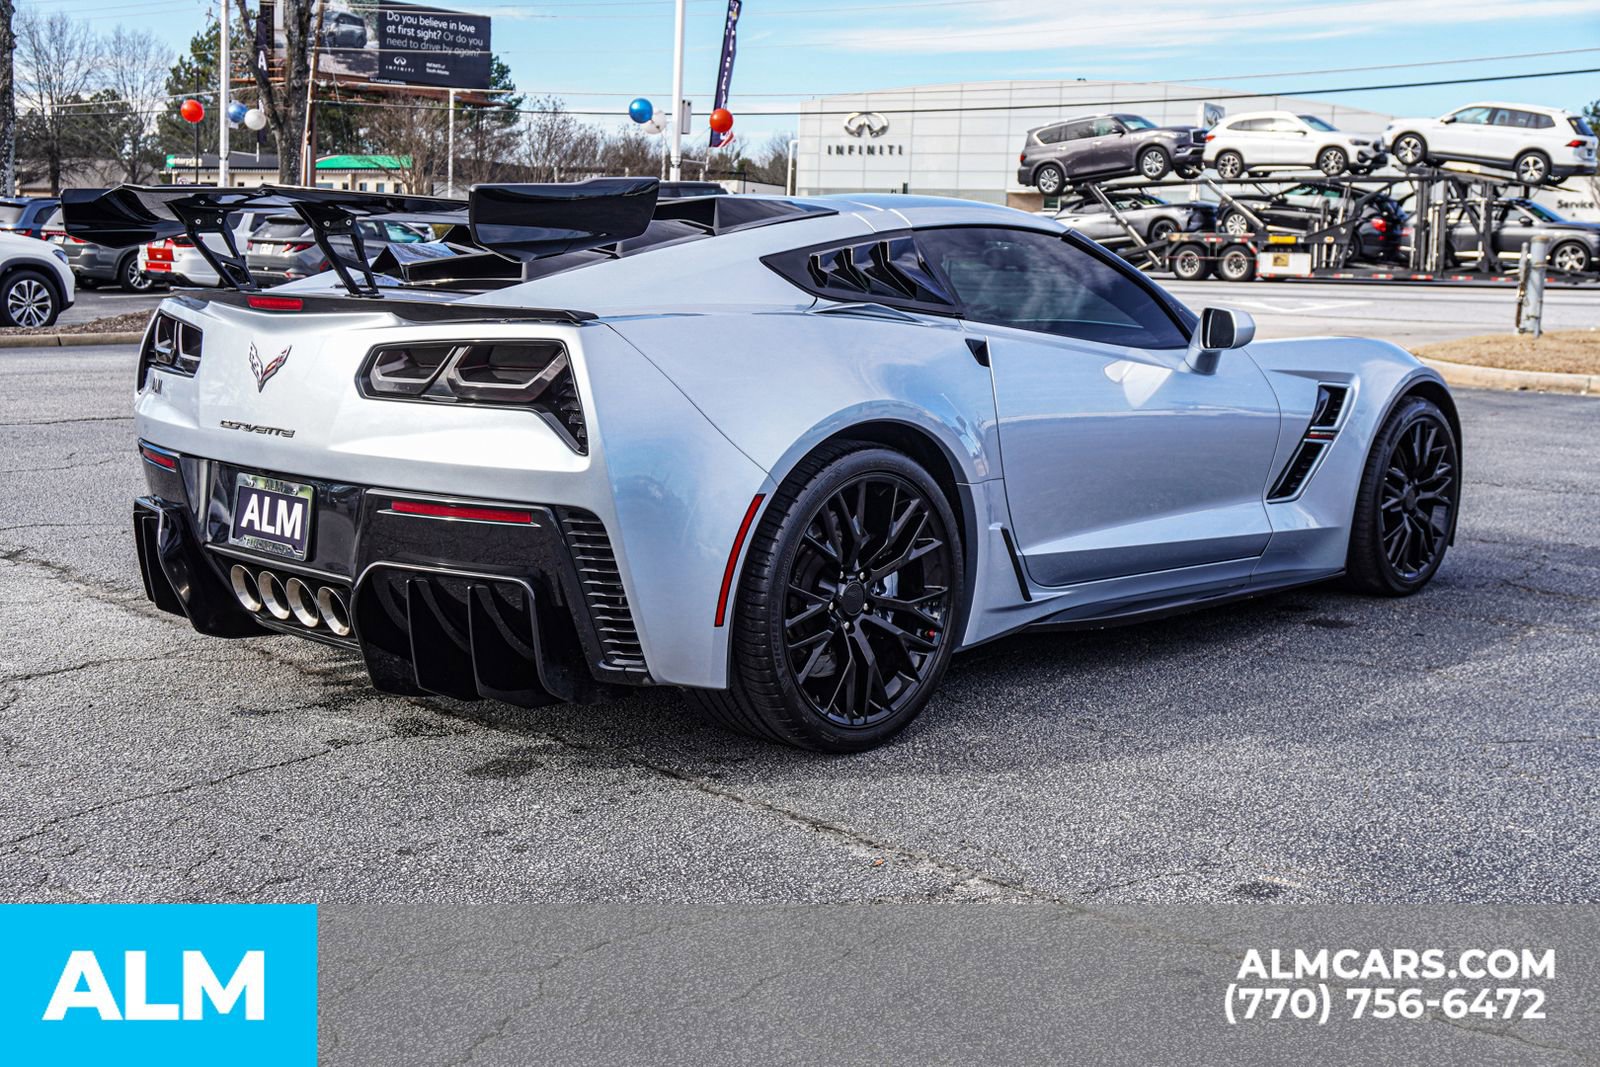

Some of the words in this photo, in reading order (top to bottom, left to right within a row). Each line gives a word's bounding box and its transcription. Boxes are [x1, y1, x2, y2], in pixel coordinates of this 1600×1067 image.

[386, 10, 400, 22] Do
[402, 16, 417, 24] you
[419, 16, 447, 29] believe
[449, 20, 457, 30] in
[458, 22, 475, 33] love
[386, 25, 396, 33] at
[398, 25, 414, 36] first
[417, 28, 442, 40] sight?
[443, 32, 454, 41] Or
[456, 34, 467, 43] do
[468, 38, 483, 46] you
[386, 38, 407, 47] need
[409, 40, 418, 48] to
[420, 41, 441, 52] drive
[442, 44, 452, 54] by
[454, 47, 481, 58] again?
[828, 145, 903, 155] INFINITI
[1557, 200, 1594, 208] Service
[220, 420, 295, 438] CORVETTE
[241, 494, 302, 540] ALM
